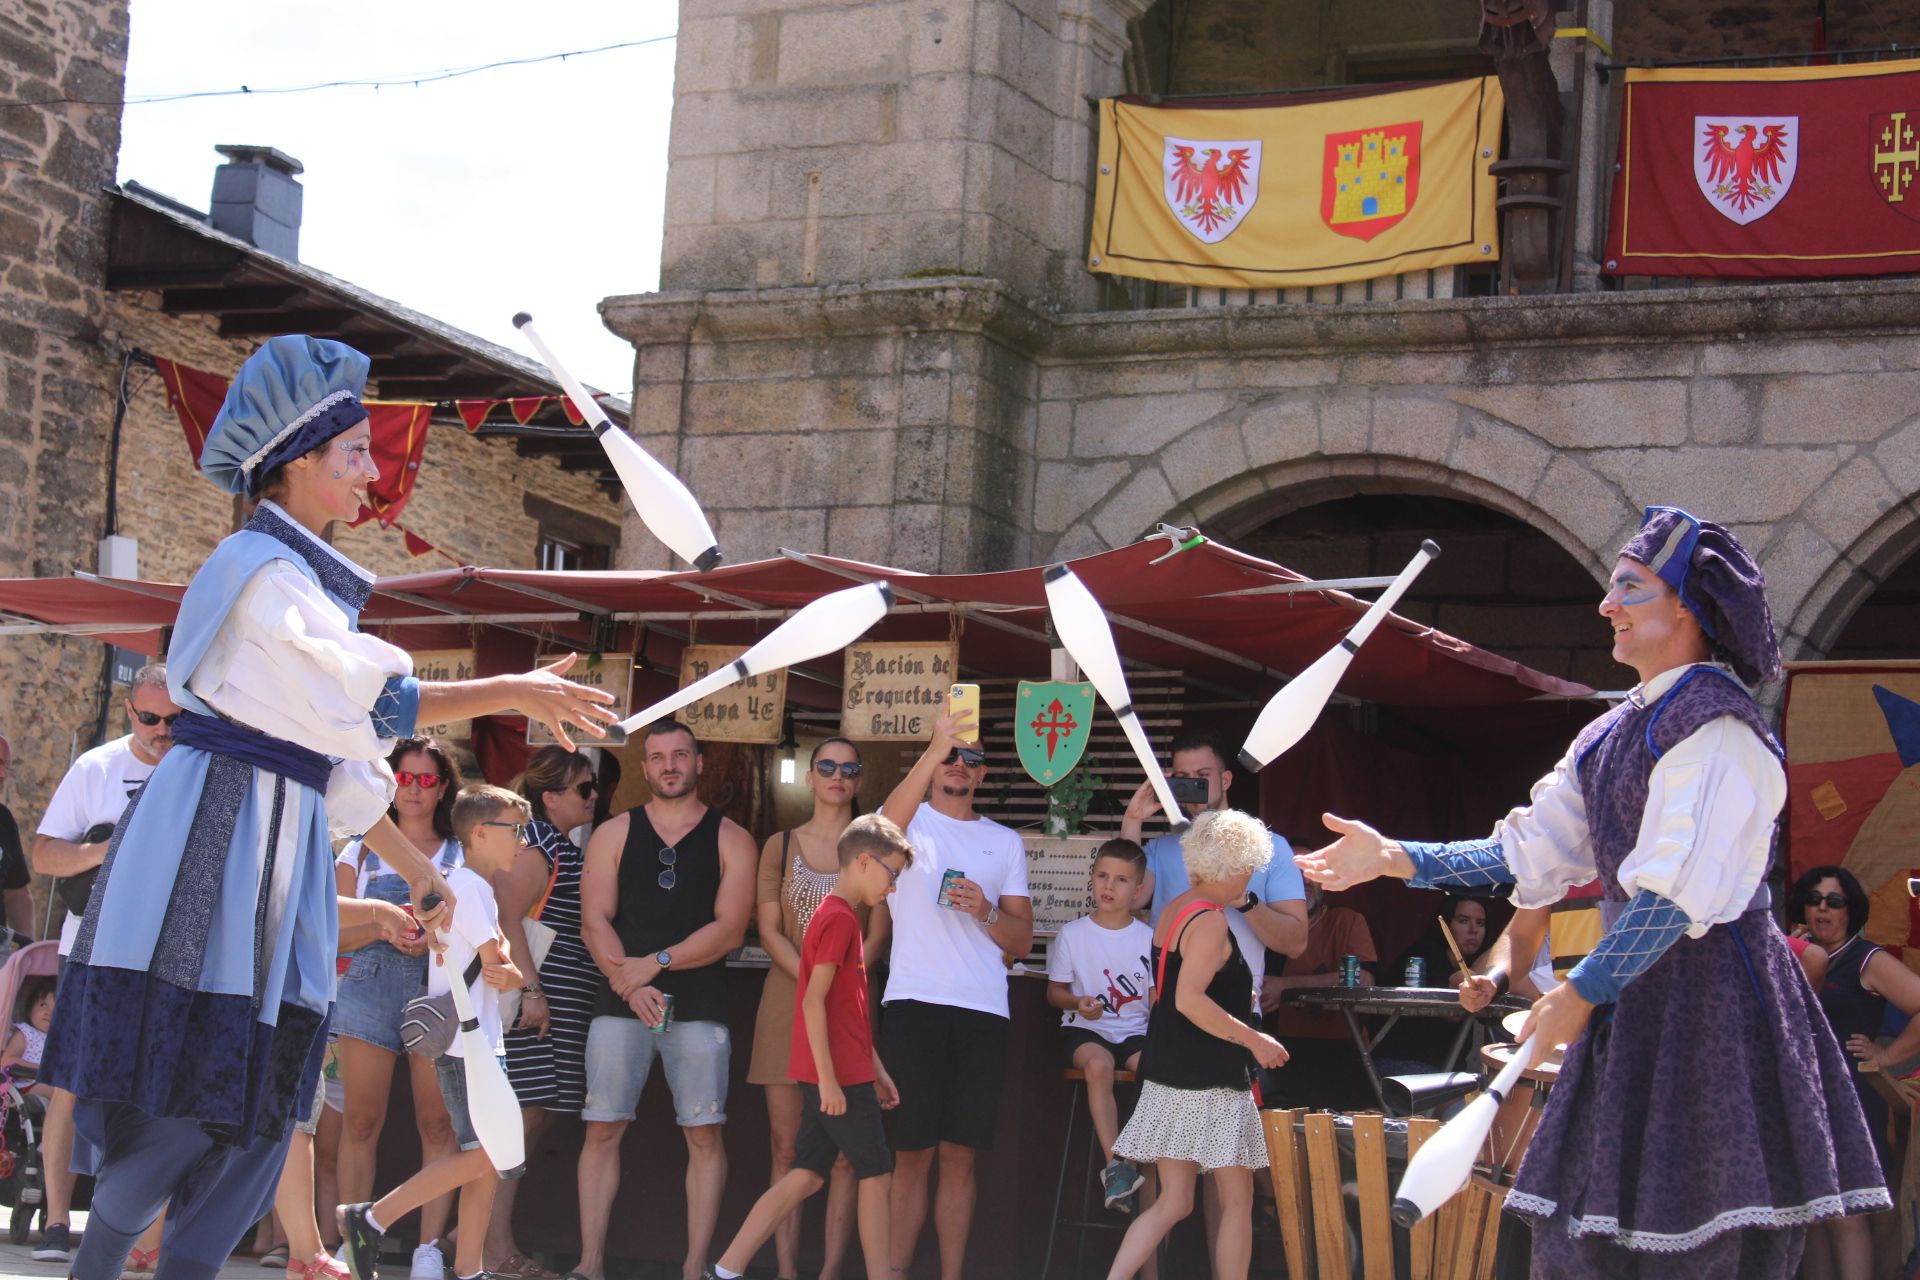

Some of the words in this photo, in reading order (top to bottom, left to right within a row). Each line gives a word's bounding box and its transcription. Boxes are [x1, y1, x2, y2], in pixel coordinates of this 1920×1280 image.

[851, 651, 925, 680] Ración
[932, 653, 951, 676] de
[847, 681, 944, 710] Croquetas
